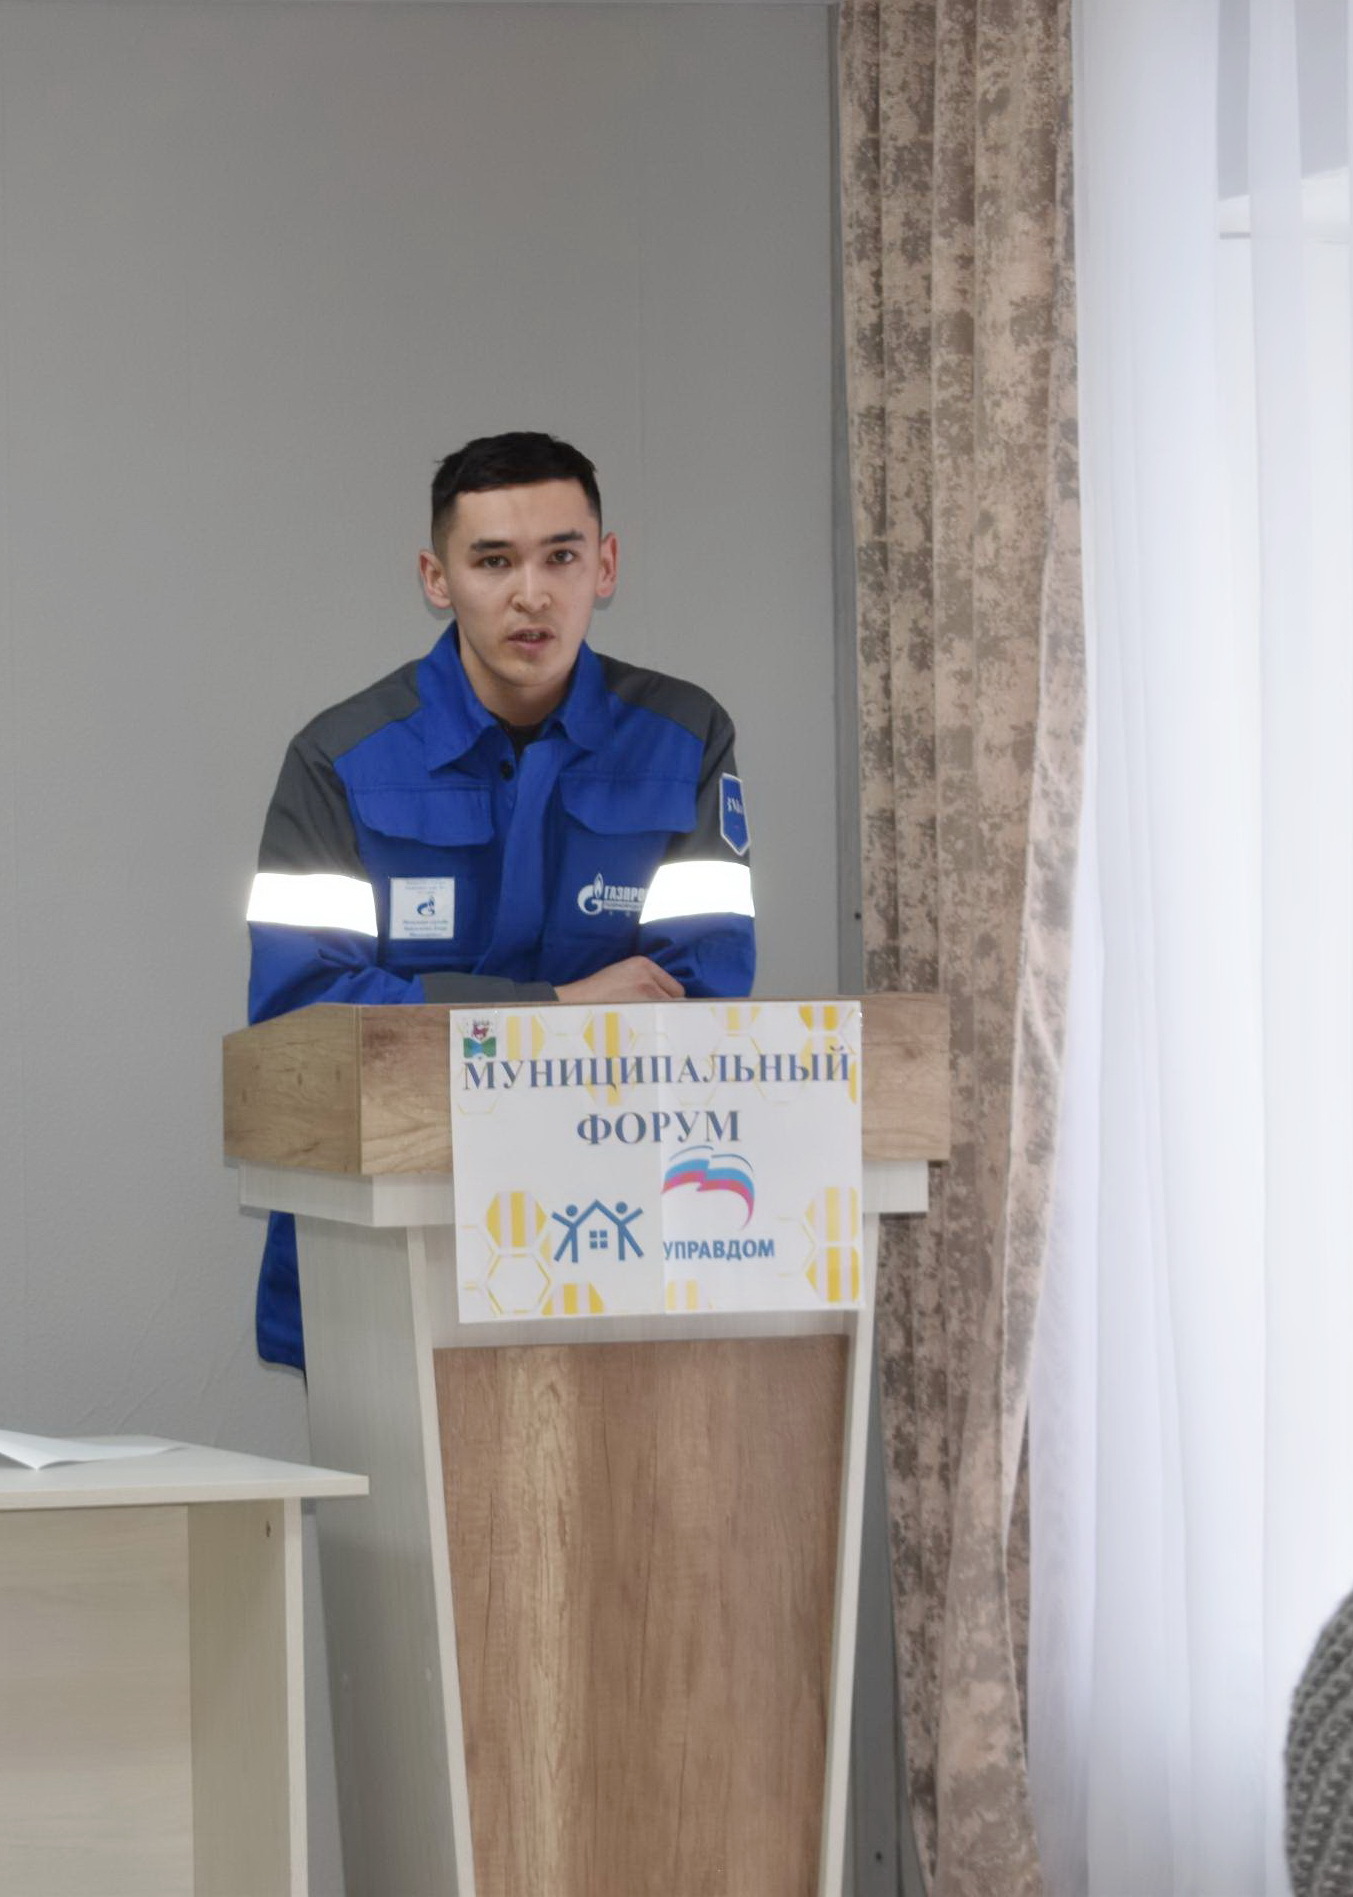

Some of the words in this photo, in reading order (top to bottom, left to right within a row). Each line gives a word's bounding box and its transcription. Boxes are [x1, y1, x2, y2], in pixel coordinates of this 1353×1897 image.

[604, 885, 648, 902] ГАЗПРО
[463, 1045, 850, 1093] МУНИЦИПАЛЬНЫЙ
[576, 1110, 741, 1146] ФОРУМ
[663, 1238, 775, 1261] УПРАВДОМ
